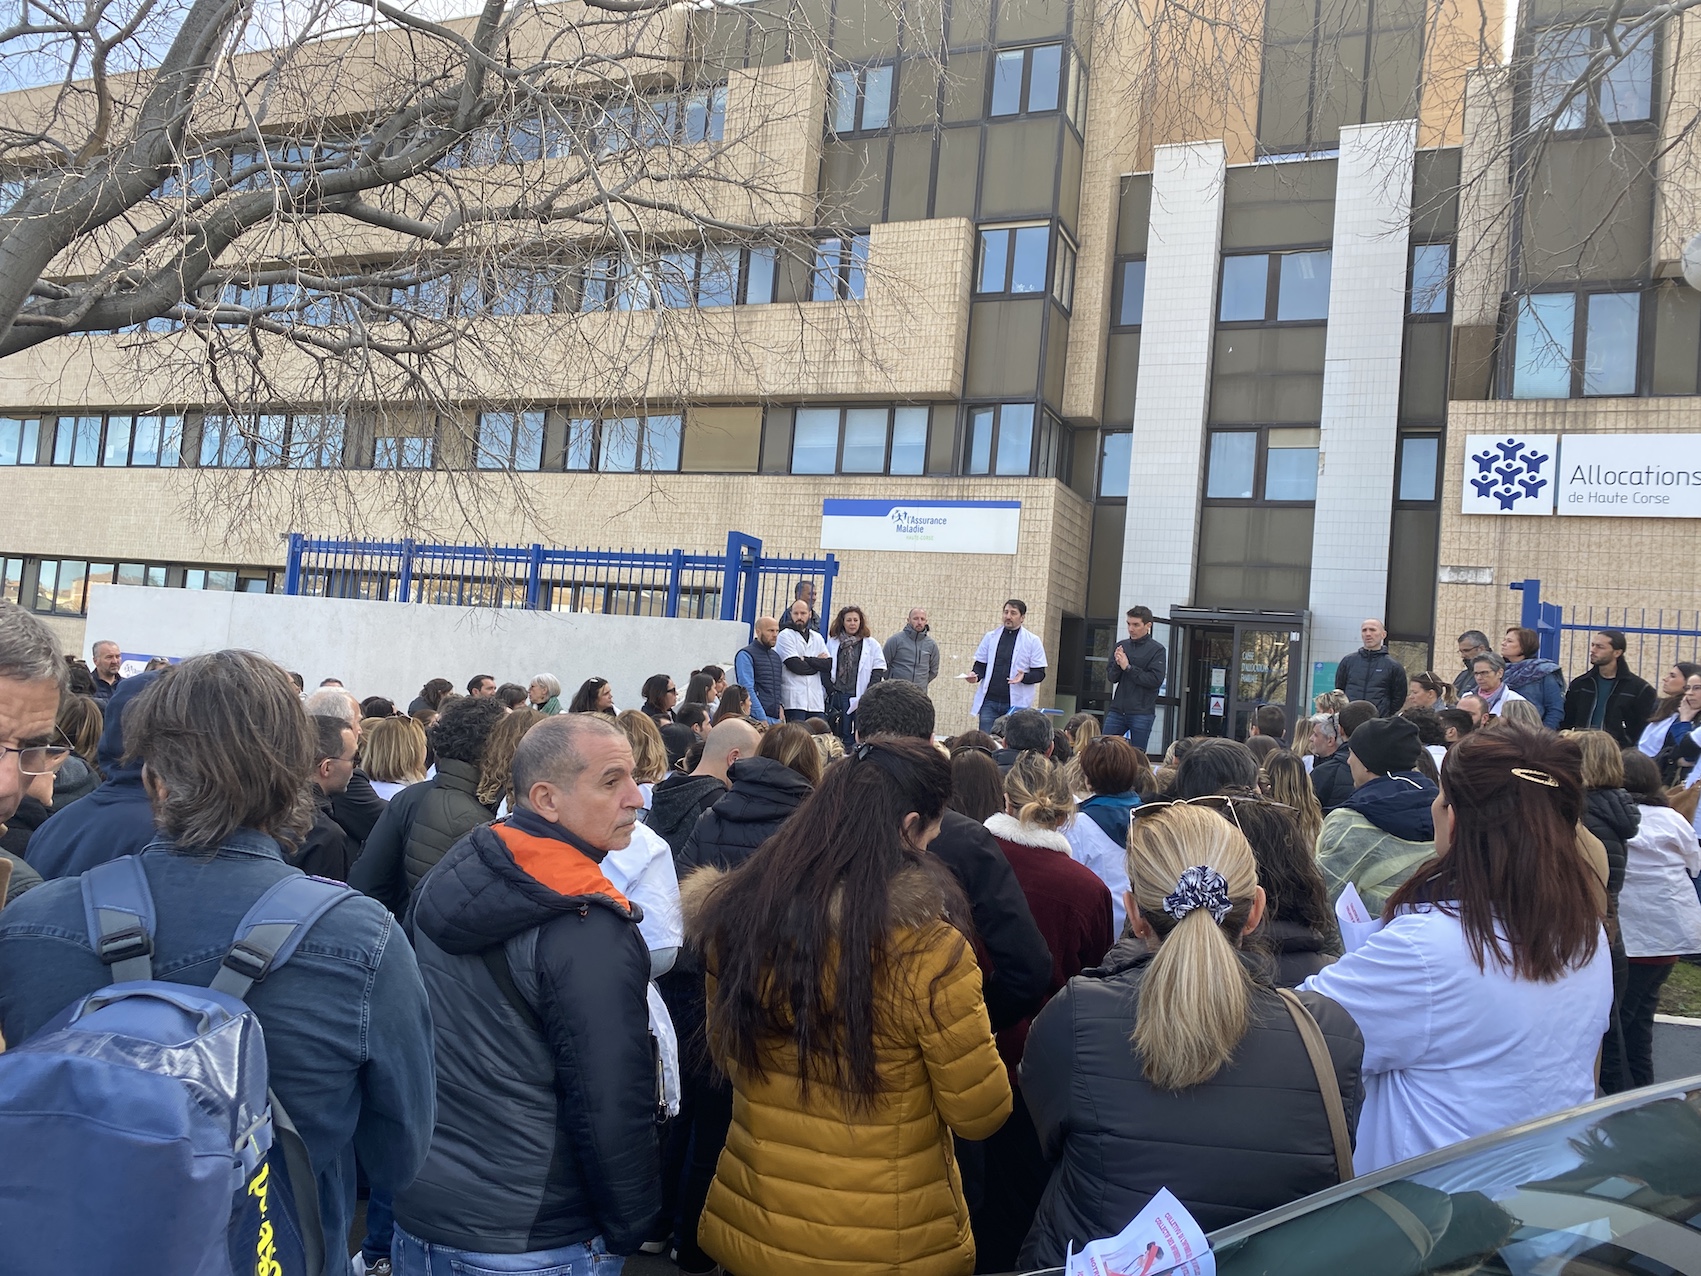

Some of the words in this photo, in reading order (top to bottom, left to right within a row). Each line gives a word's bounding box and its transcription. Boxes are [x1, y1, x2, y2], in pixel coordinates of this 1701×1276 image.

[1569, 464, 1701, 486] Allocations
[1568, 491, 1584, 503] de
[1588, 491, 1628, 504] Haute
[1632, 491, 1670, 504] Corse
[907, 515, 947, 525] l'Assurance
[896, 524, 924, 533] Maladie
